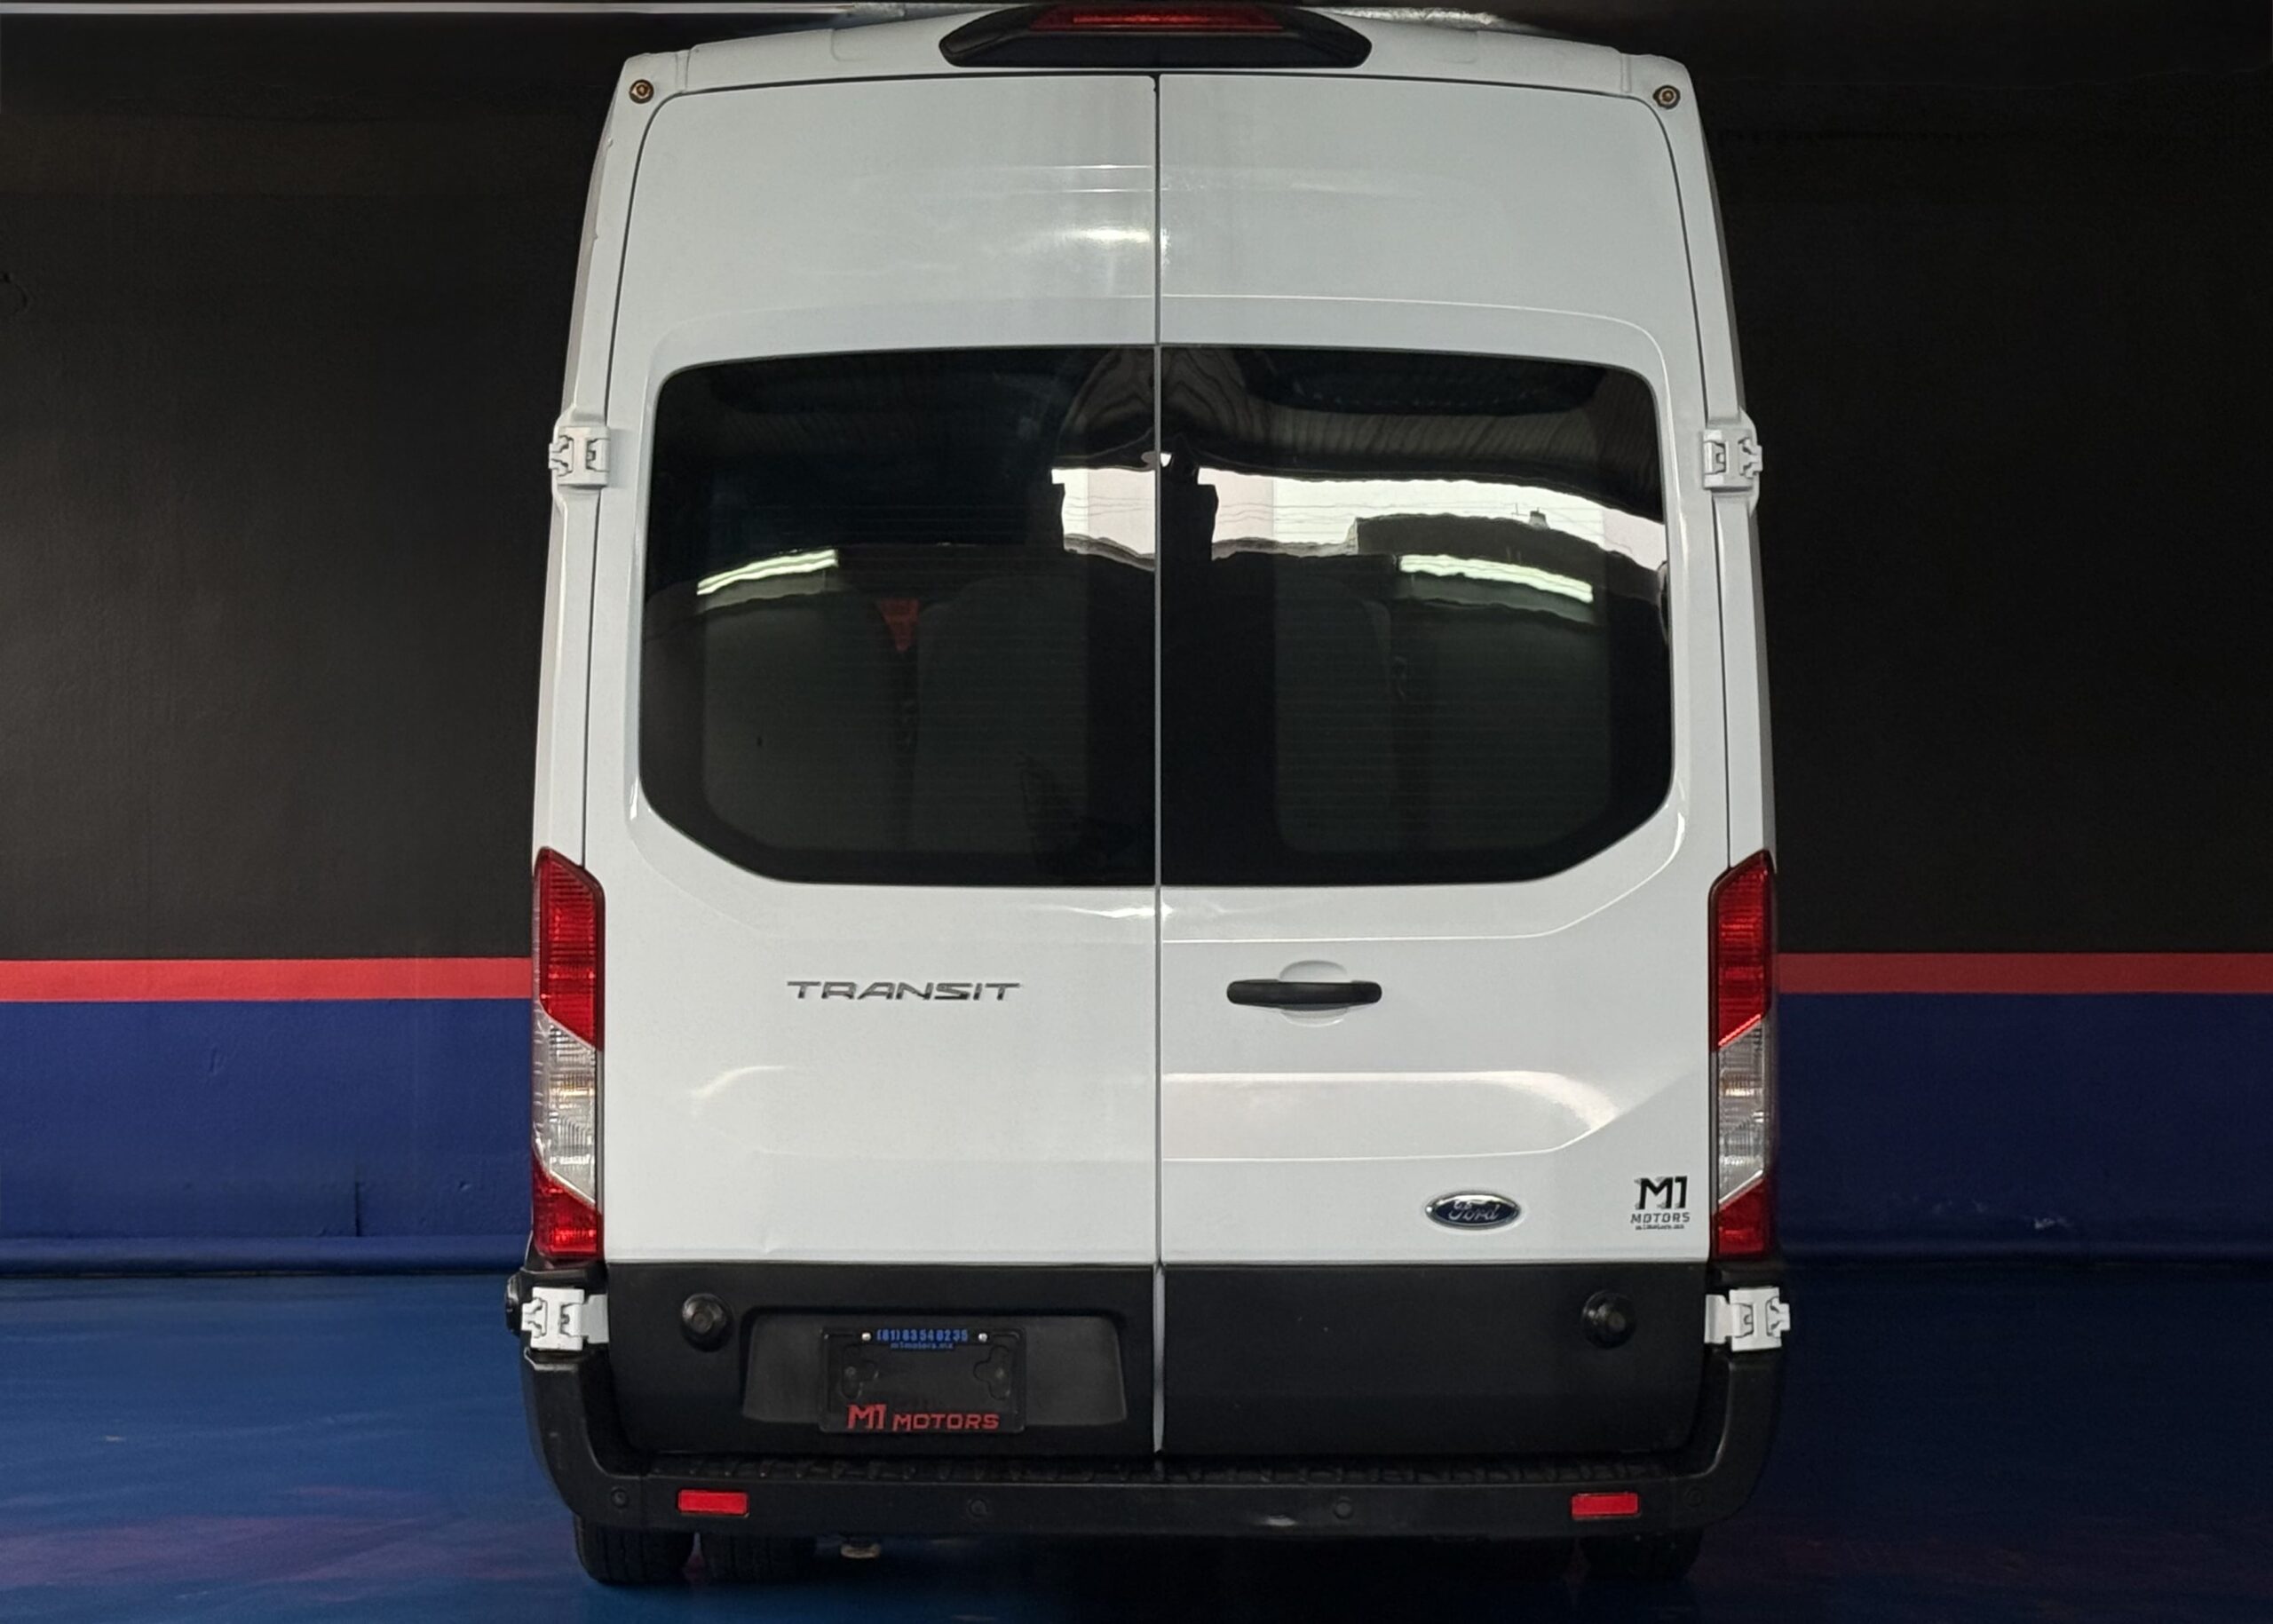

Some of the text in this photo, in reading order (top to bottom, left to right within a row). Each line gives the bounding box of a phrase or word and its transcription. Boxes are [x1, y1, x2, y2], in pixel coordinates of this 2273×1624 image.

[787, 981, 1021, 1001] TRANSIT
[1635, 1175, 1688, 1209] M1
[1448, 1199, 1501, 1222] Ford
[1630, 1211, 1691, 1224] MOTORS
[847, 1403, 1000, 1431] M1 MOTORS
